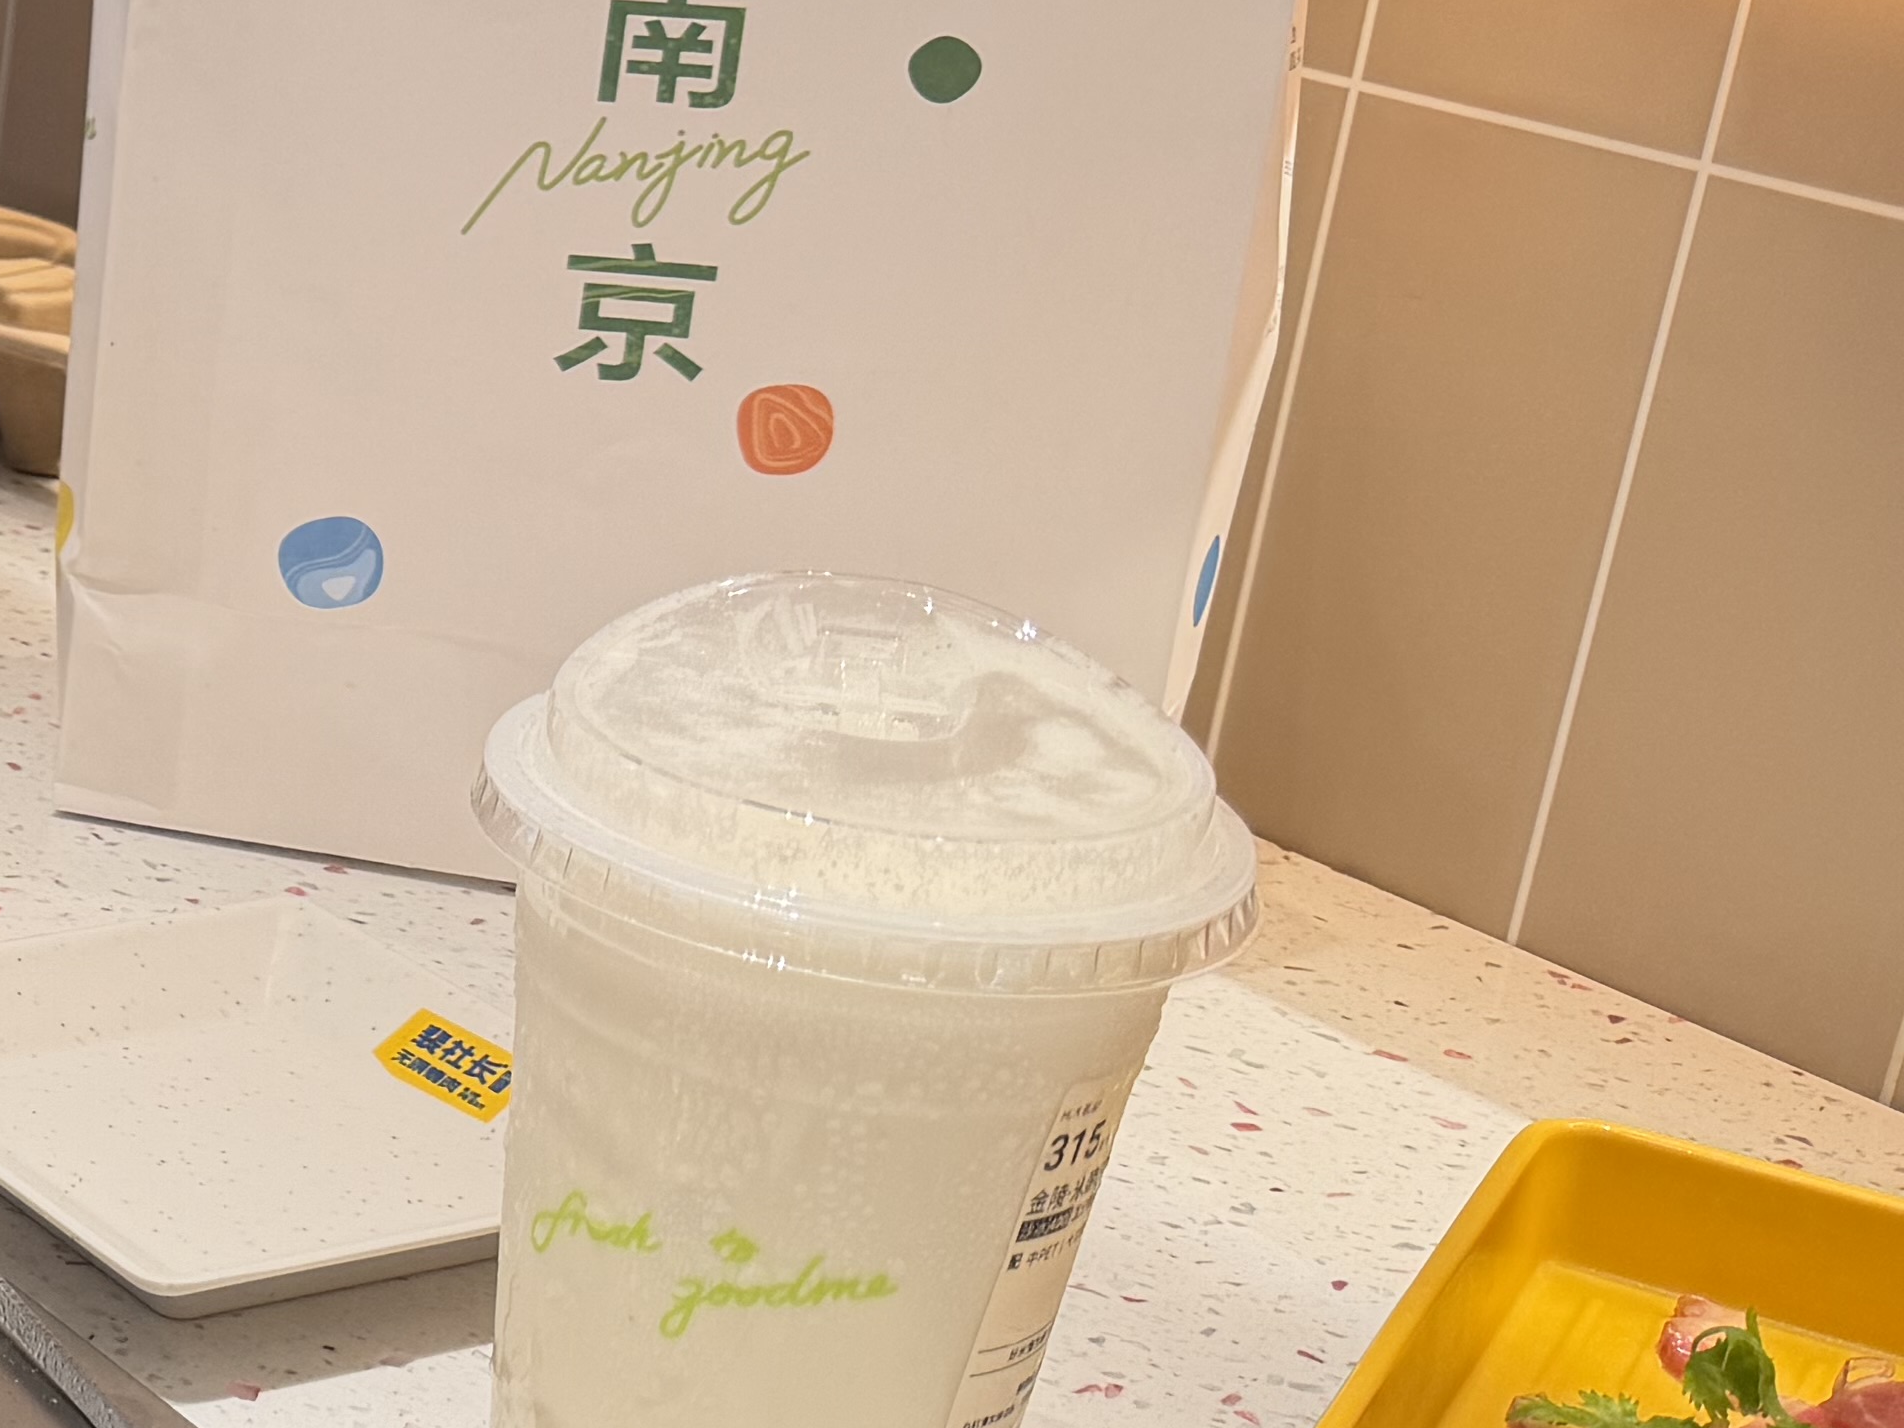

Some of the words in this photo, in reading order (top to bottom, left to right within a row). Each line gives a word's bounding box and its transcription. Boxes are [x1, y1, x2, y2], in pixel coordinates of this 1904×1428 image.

[460, 116, 811, 236] Nanjing
[553, 243, 719, 382] 京
[658, 1252, 900, 1341] goodme
